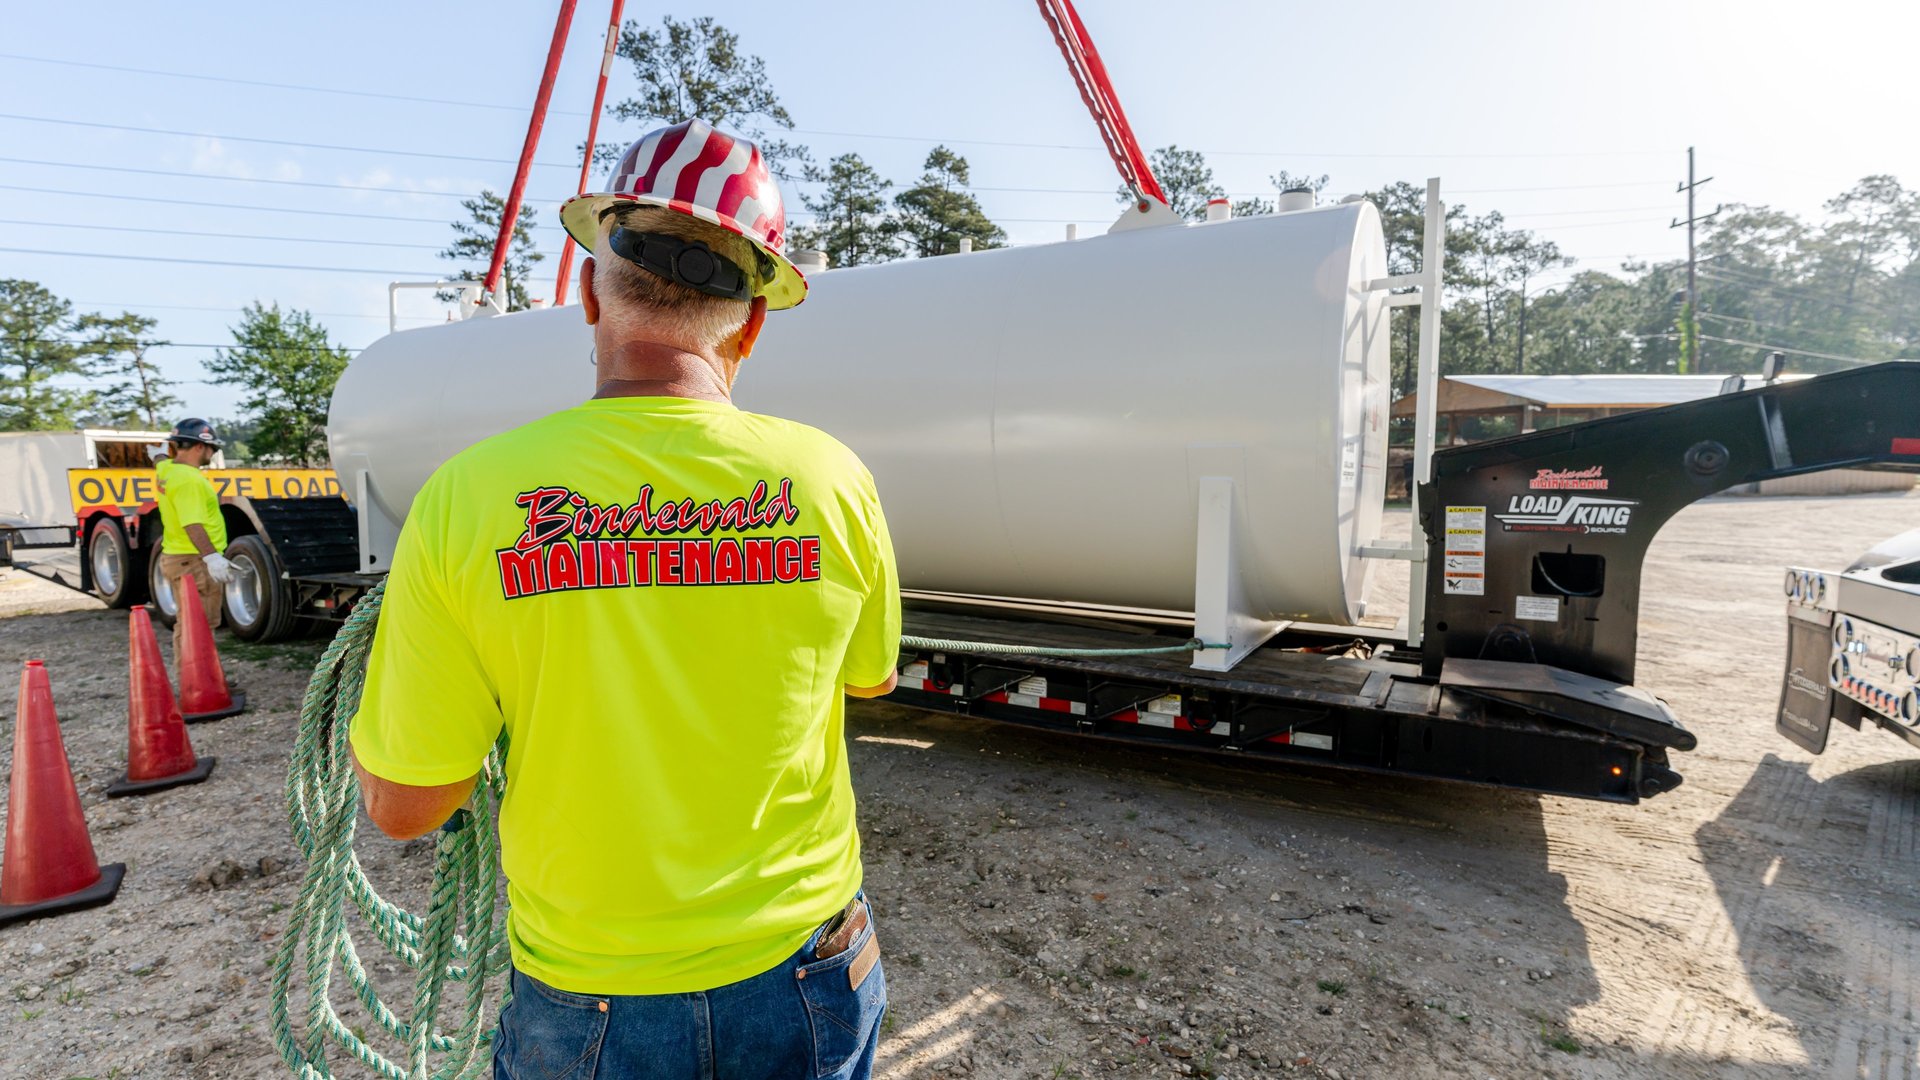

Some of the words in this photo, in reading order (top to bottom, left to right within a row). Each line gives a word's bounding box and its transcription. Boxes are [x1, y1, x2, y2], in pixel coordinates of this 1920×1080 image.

[78, 477, 254, 504] OVEZE
[266, 477, 343, 498] LOAD
[1530, 479, 1608, 489] MAINTENANCE
[515, 476, 800, 550] Bindewald
[1508, 495, 1562, 513] LOAD
[1573, 507, 1631, 525] KING
[495, 536, 820, 600] MAINTENANCE
